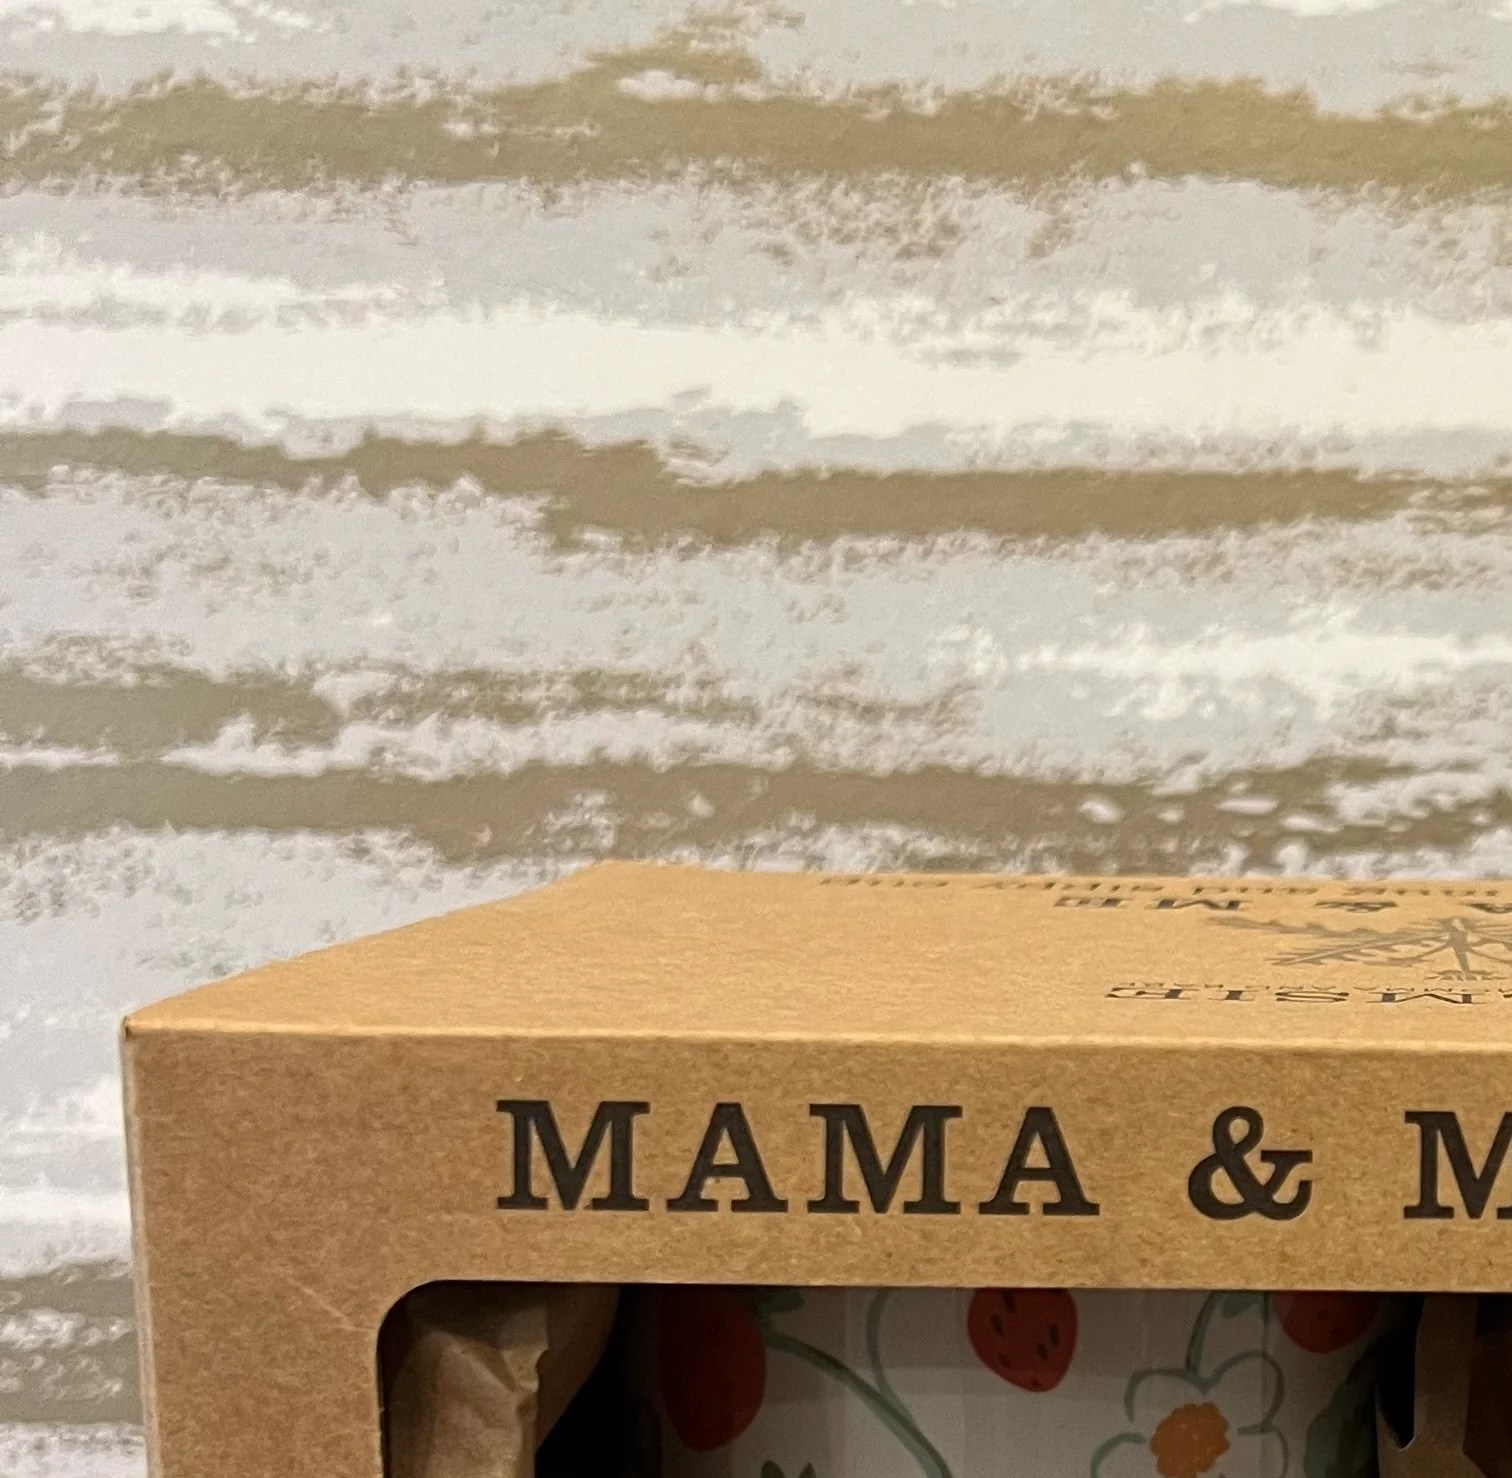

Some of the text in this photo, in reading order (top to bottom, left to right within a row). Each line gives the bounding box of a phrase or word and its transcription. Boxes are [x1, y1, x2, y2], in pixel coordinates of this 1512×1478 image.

[1052, 897, 1246, 911] ME
[1315, 900, 1398, 914] &
[497, 1100, 1099, 1215] MAMA
[1188, 1107, 1312, 1220] &
